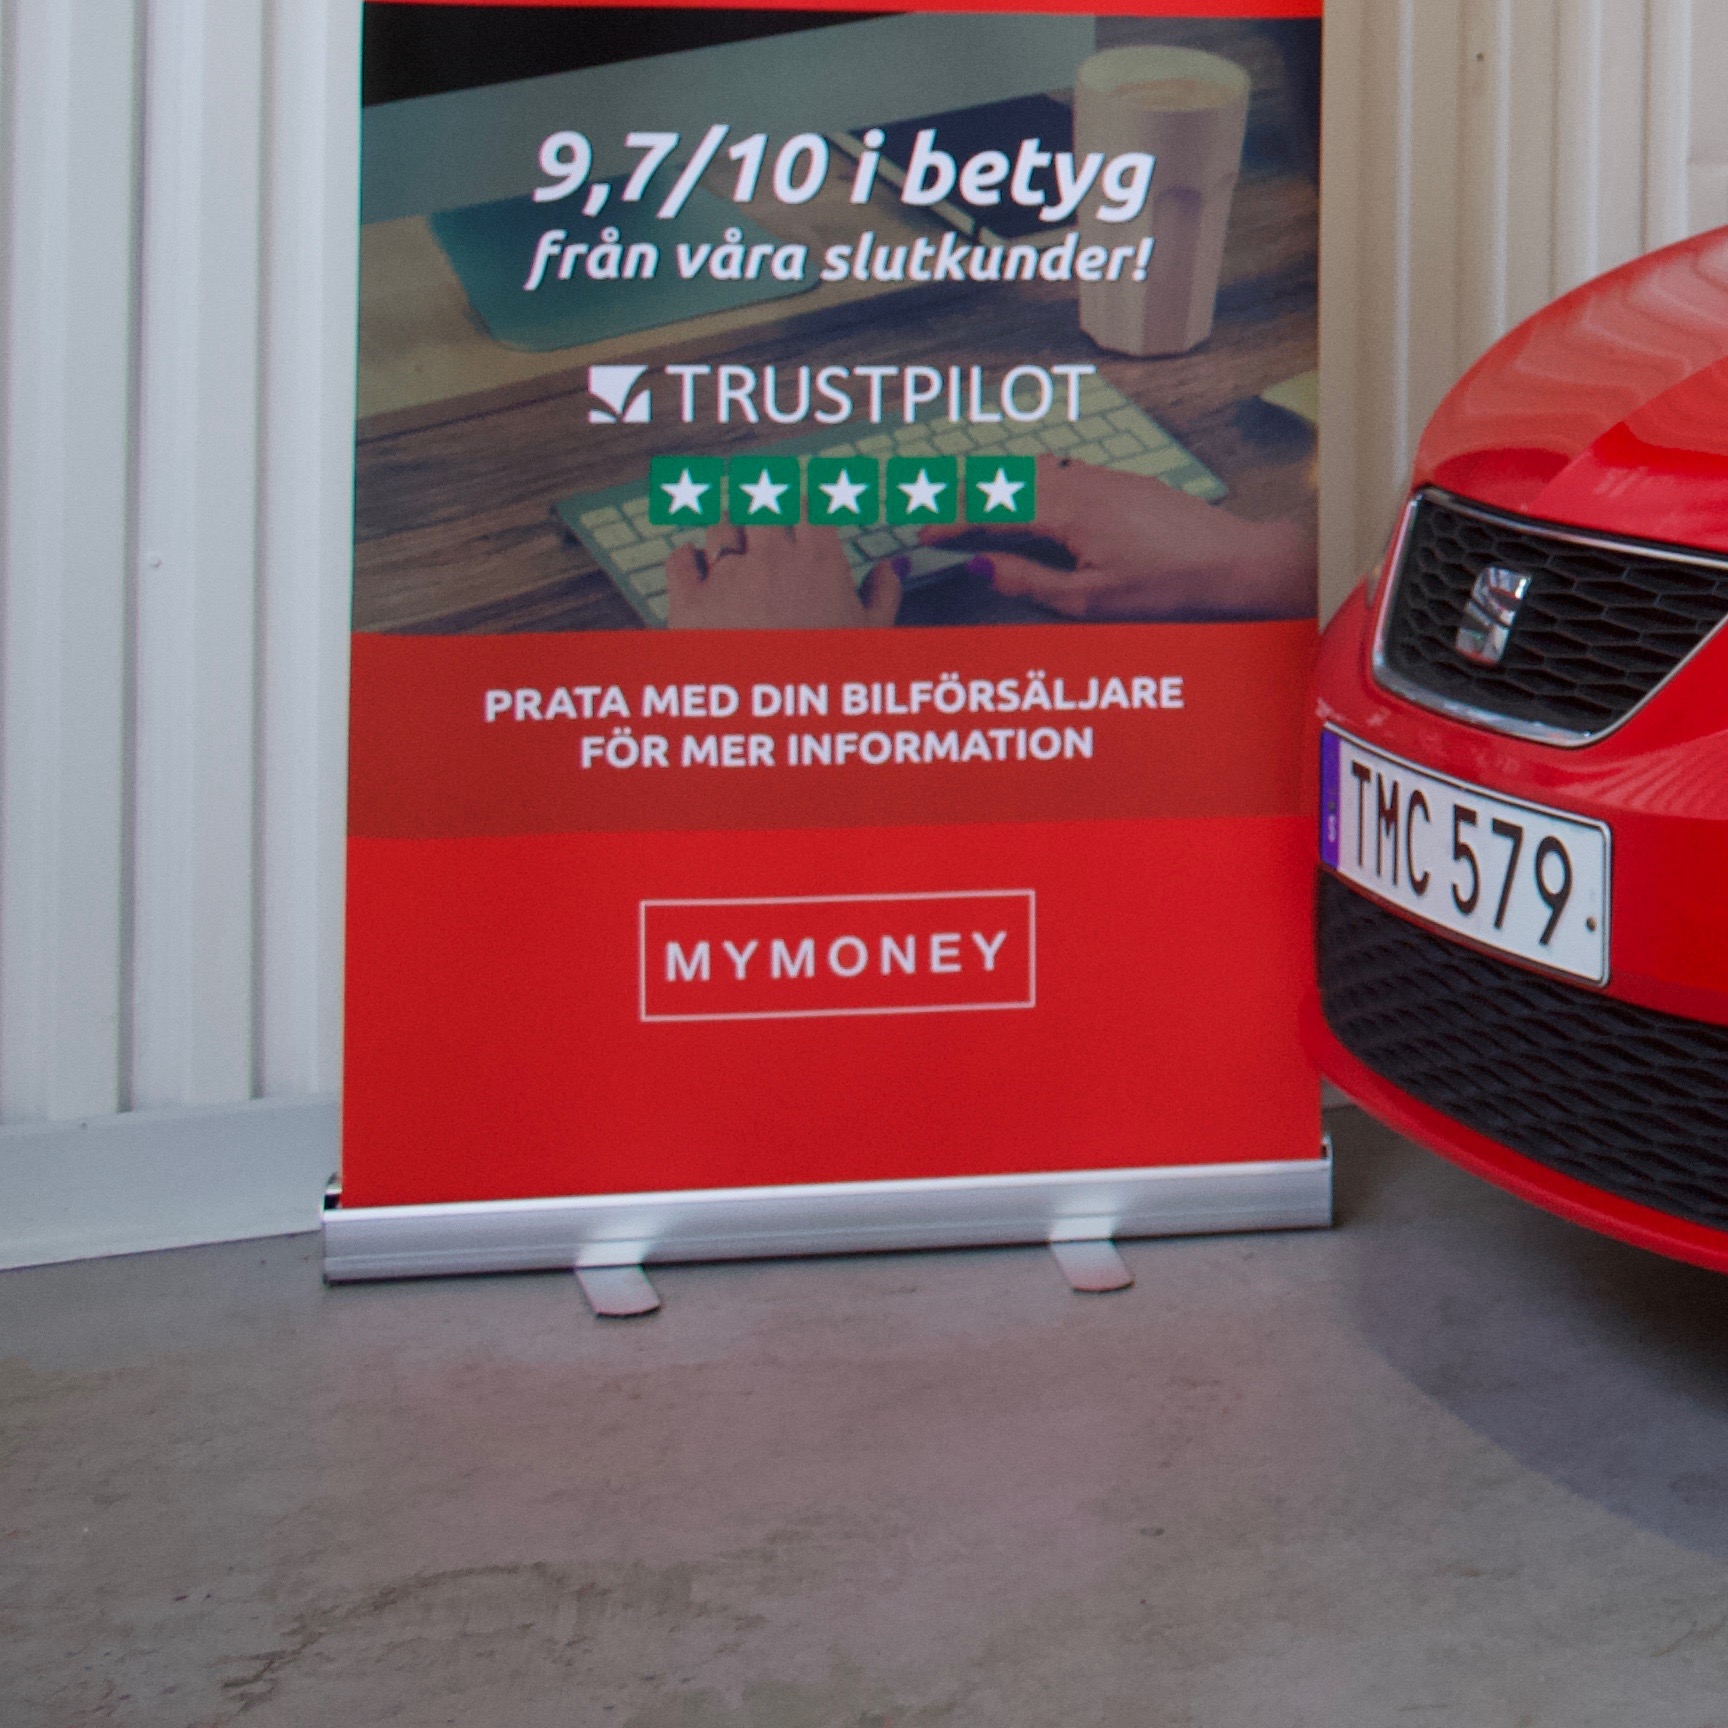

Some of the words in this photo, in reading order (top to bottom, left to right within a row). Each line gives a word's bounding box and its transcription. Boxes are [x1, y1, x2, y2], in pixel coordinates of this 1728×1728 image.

[535, 125, 828, 218] 9,7/10
[851, 130, 884, 203] i
[902, 130, 1155, 222] betyg
[526, 227, 658, 290] från
[678, 228, 806, 280] våra
[821, 232, 1153, 281] slutkunder!
[667, 365, 1095, 423] TRUSTPILOT
[486, 686, 630, 722] PRATA
[643, 685, 739, 717] MED
[753, 684, 827, 717] DIN
[842, 670, 1183, 715] BILFÖRSÄLJARE
[582, 727, 668, 768] FÖR
[682, 734, 774, 767] MER
[789, 727, 1092, 765] INFORMATION
[1352, 760, 1430, 896] TMC
[1452, 802, 1573, 946] 579
[666, 931, 1006, 981] MYMONEY
